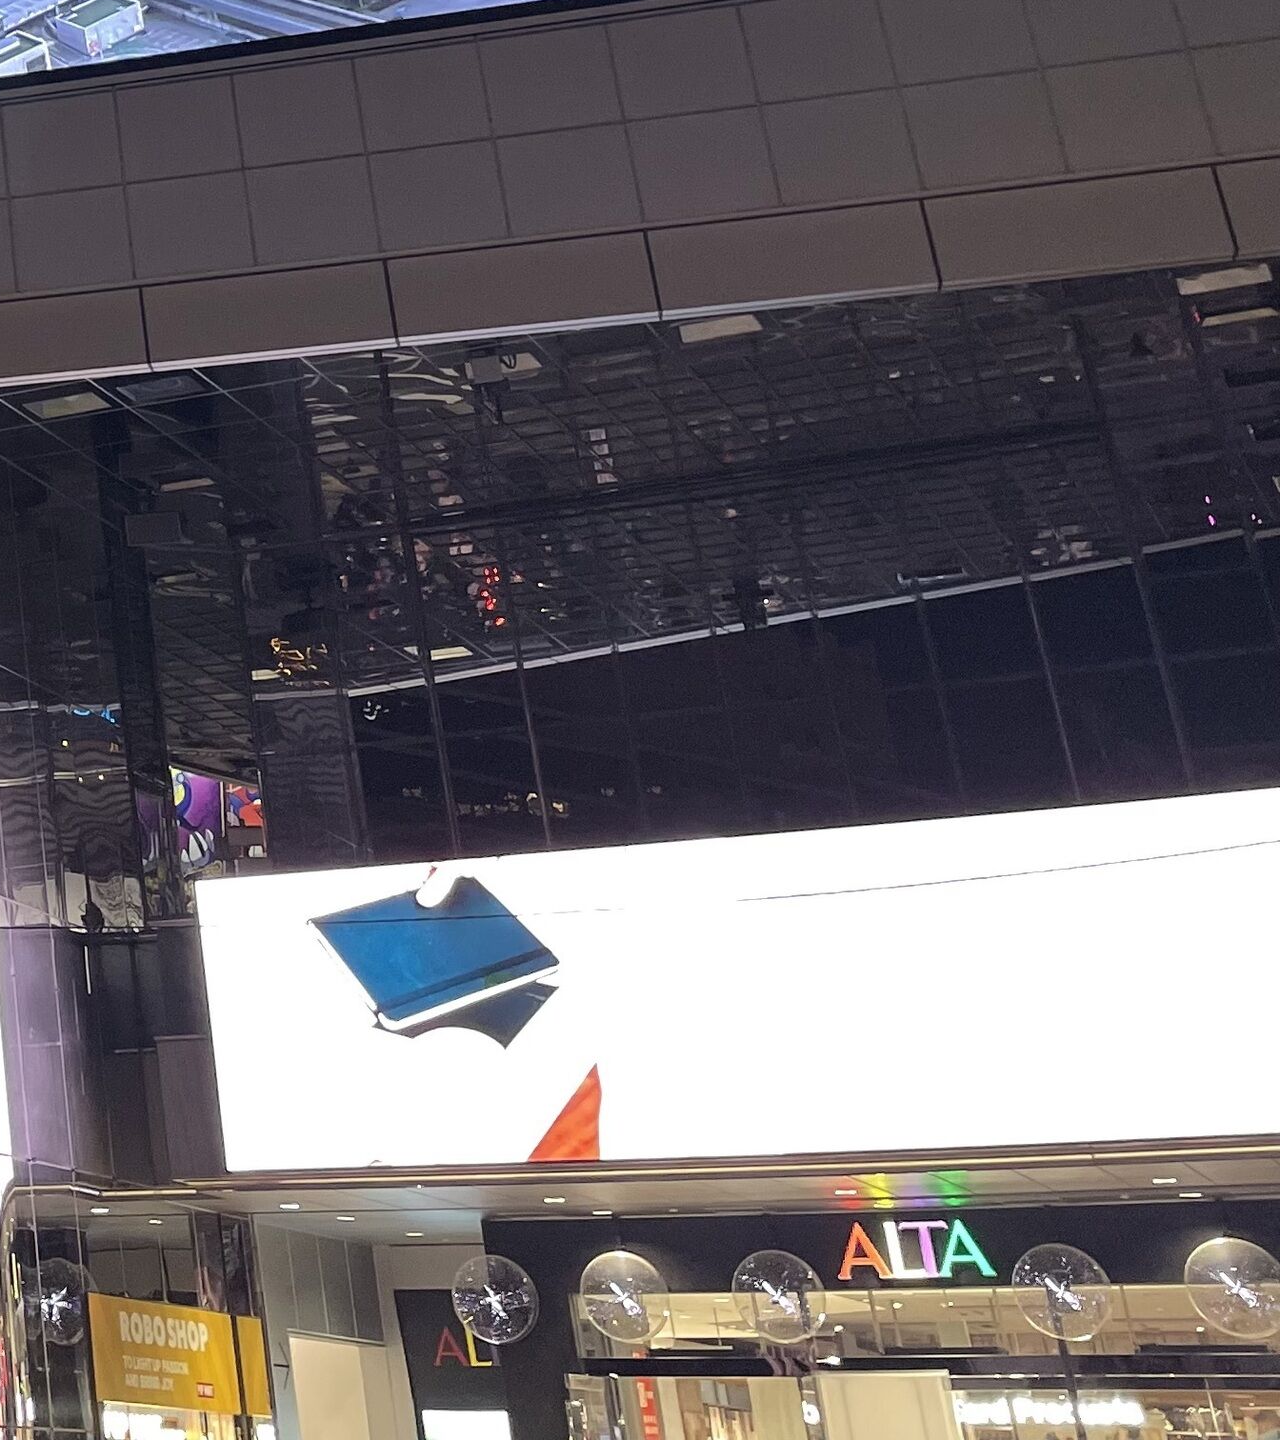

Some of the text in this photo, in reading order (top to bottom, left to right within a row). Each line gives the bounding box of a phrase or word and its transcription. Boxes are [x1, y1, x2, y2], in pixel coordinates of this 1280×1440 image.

[837, 1218, 999, 1281] ALTA
[118, 1310, 209, 1352] ROBO SHOP
